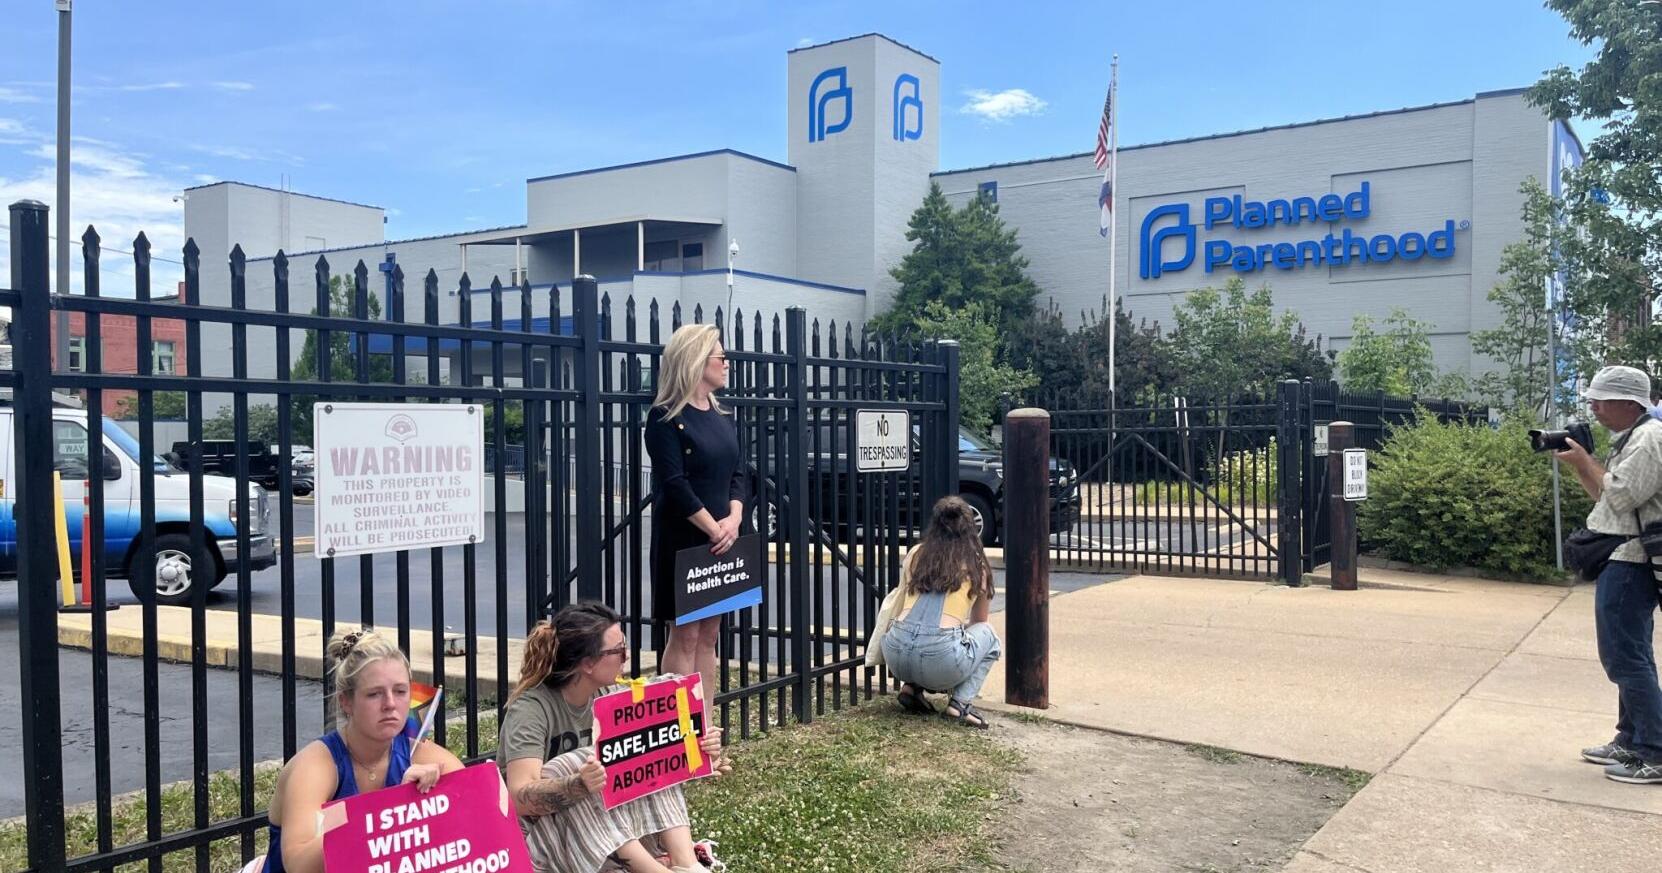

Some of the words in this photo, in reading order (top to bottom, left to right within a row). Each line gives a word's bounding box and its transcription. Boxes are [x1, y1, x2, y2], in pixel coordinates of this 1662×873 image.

[1204, 180, 1371, 231] Planned
[877, 419, 889, 437] NO
[65, 444, 84, 453] WAY
[859, 445, 907, 461] TRESPASSING
[330, 445, 473, 477] WARNING
[344, 479, 374, 491] THIS
[380, 476, 444, 490] PROPERTY
[450, 475, 461, 486] IS
[331, 491, 409, 506] MONITORED
[415, 490, 431, 500] BY
[436, 488, 471, 499] VIDEO
[324, 523, 348, 534] ALL
[355, 516, 419, 532] CRIMINAL
[424, 513, 477, 526] ACTIVITY
[329, 534, 363, 547] WILL
[368, 532, 385, 544] BE
[391, 525, 474, 542] PROSECUTED!
[686, 561, 734, 580] Abortion
[735, 557, 744, 568] is
[687, 575, 722, 594] Health
[723, 571, 750, 585] Care.
[613, 694, 678, 726] PROTEC
[602, 733, 646, 763] SAFE,
[648, 719, 700, 749] LEGL
[365, 812, 374, 834] I
[380, 794, 450, 830] STAND
[367, 824, 430, 859] WITH
